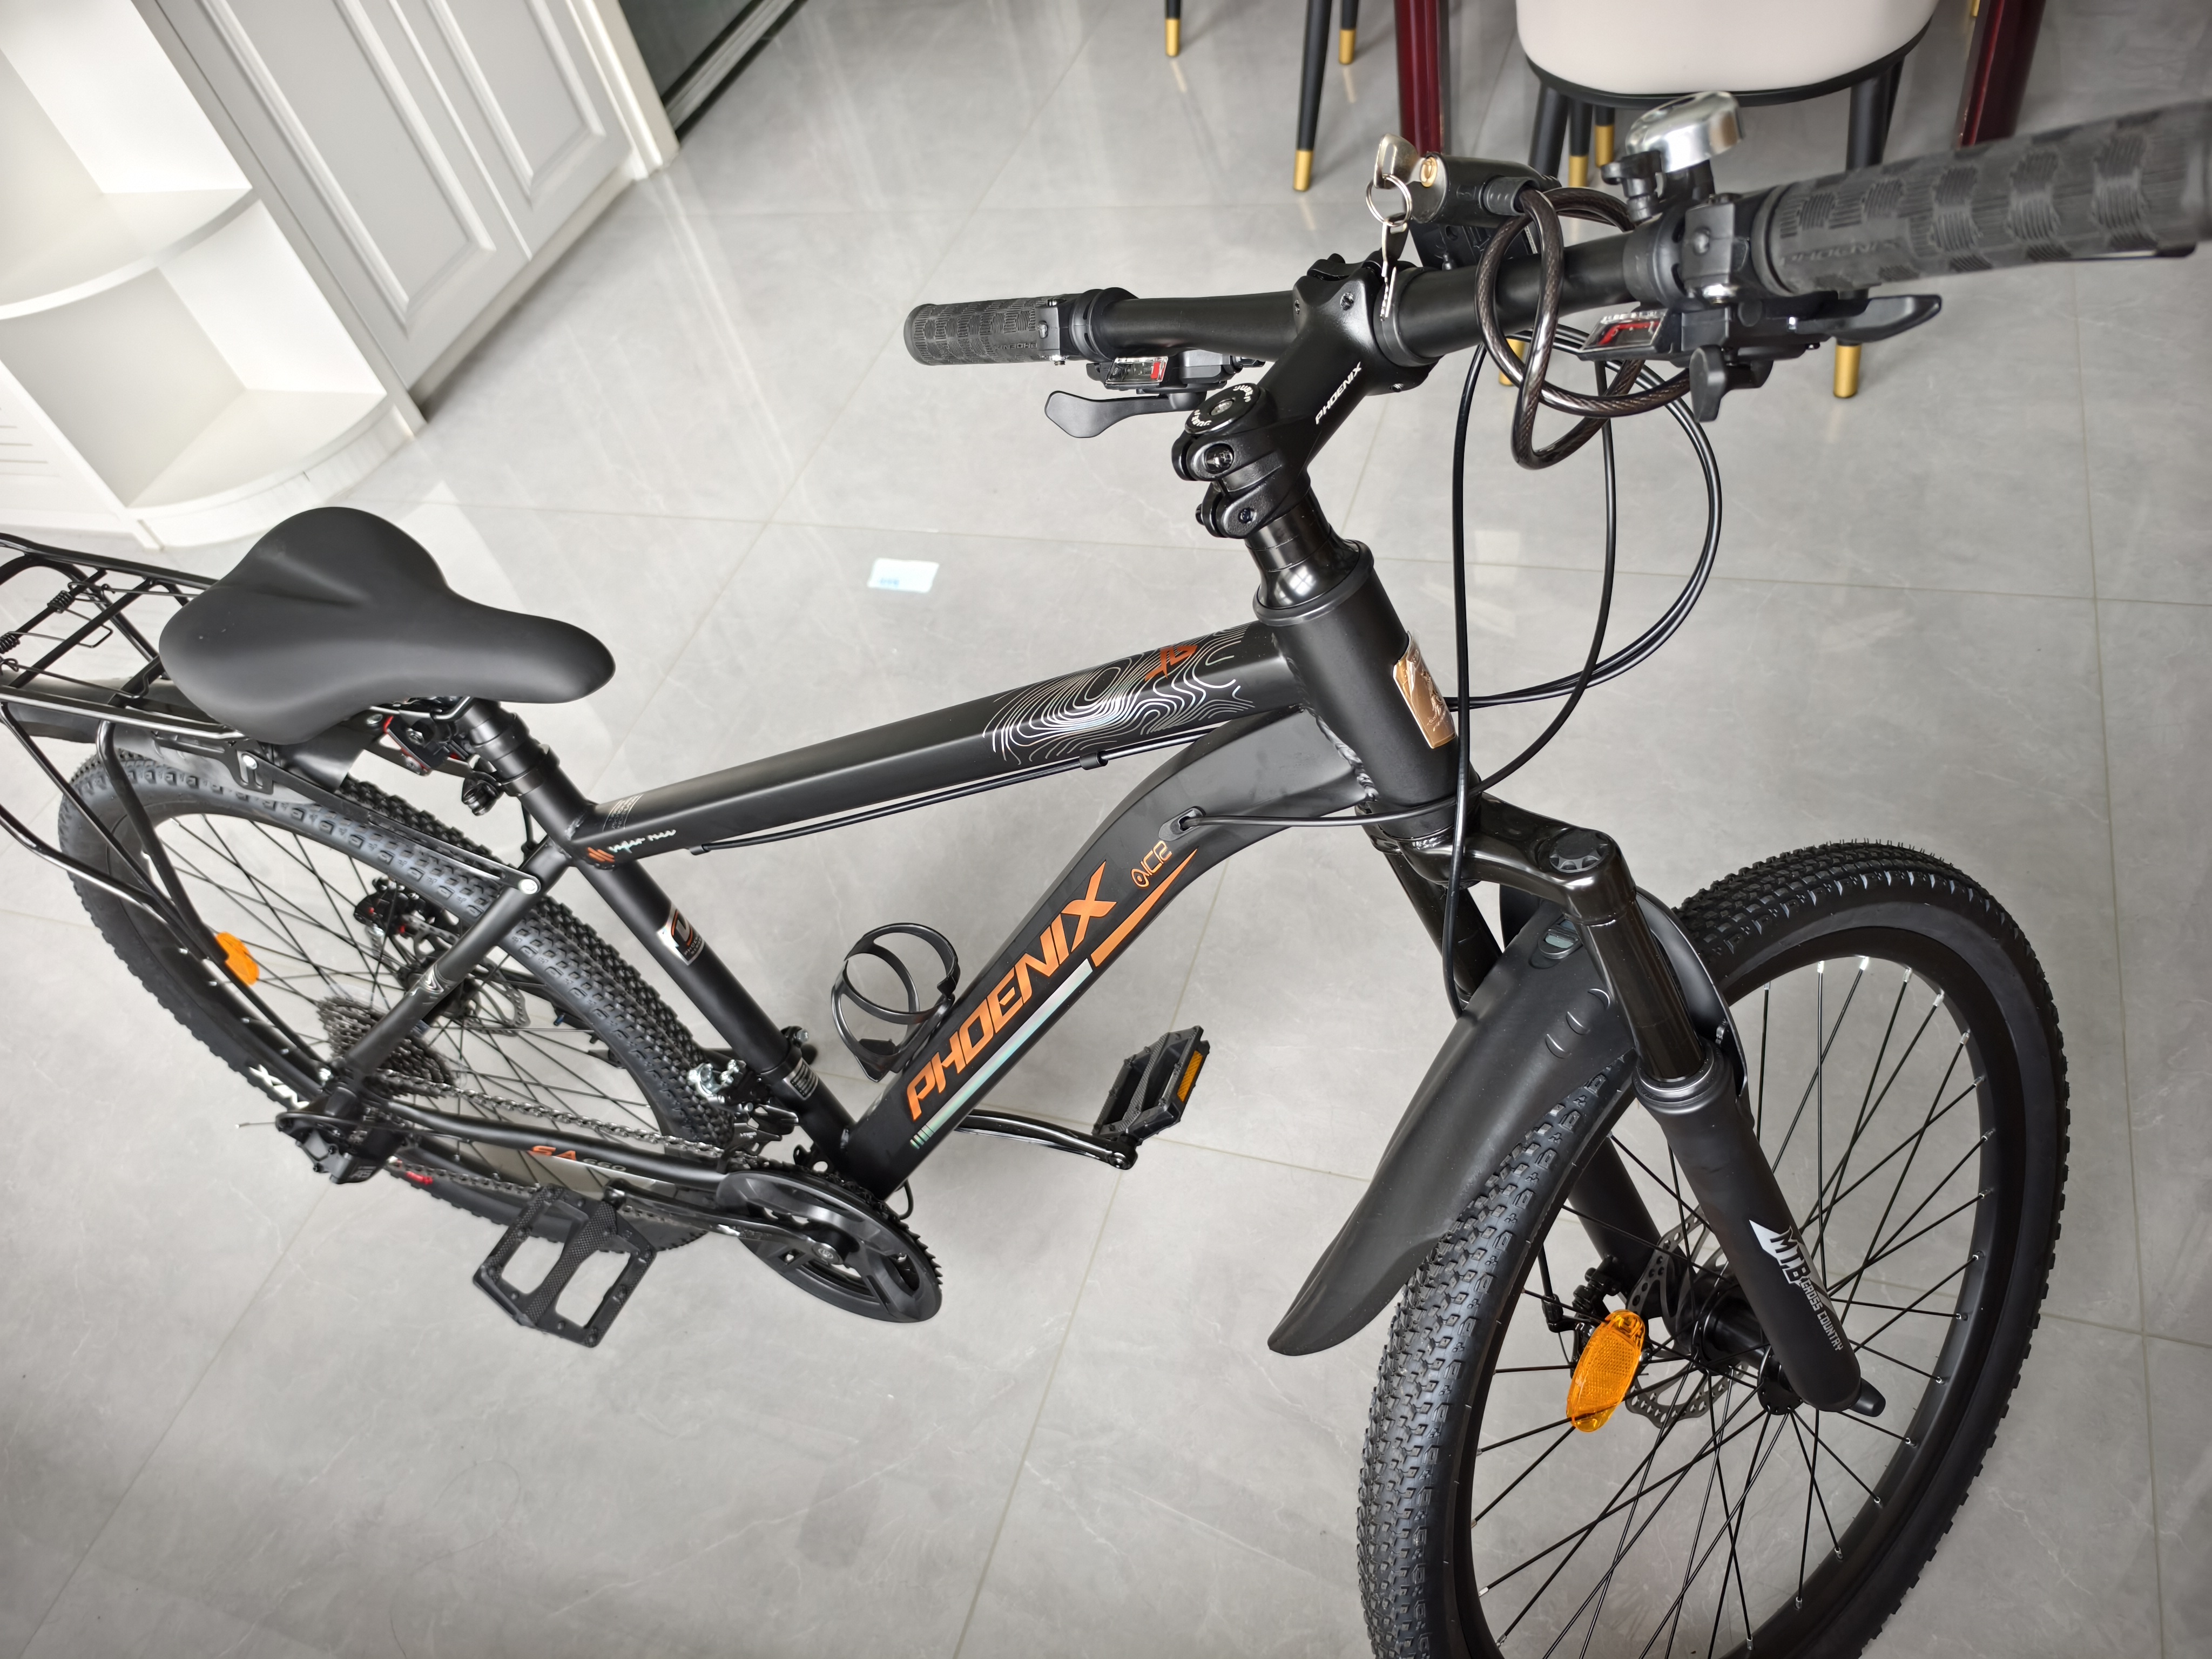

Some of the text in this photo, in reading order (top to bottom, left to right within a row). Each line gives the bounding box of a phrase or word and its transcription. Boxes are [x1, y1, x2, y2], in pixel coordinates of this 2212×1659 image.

[1315, 361, 1361, 425] PHOENIX
[906, 860, 1117, 1121] PHOENIX
[1817, 1310, 1844, 1351] COUNTRY
